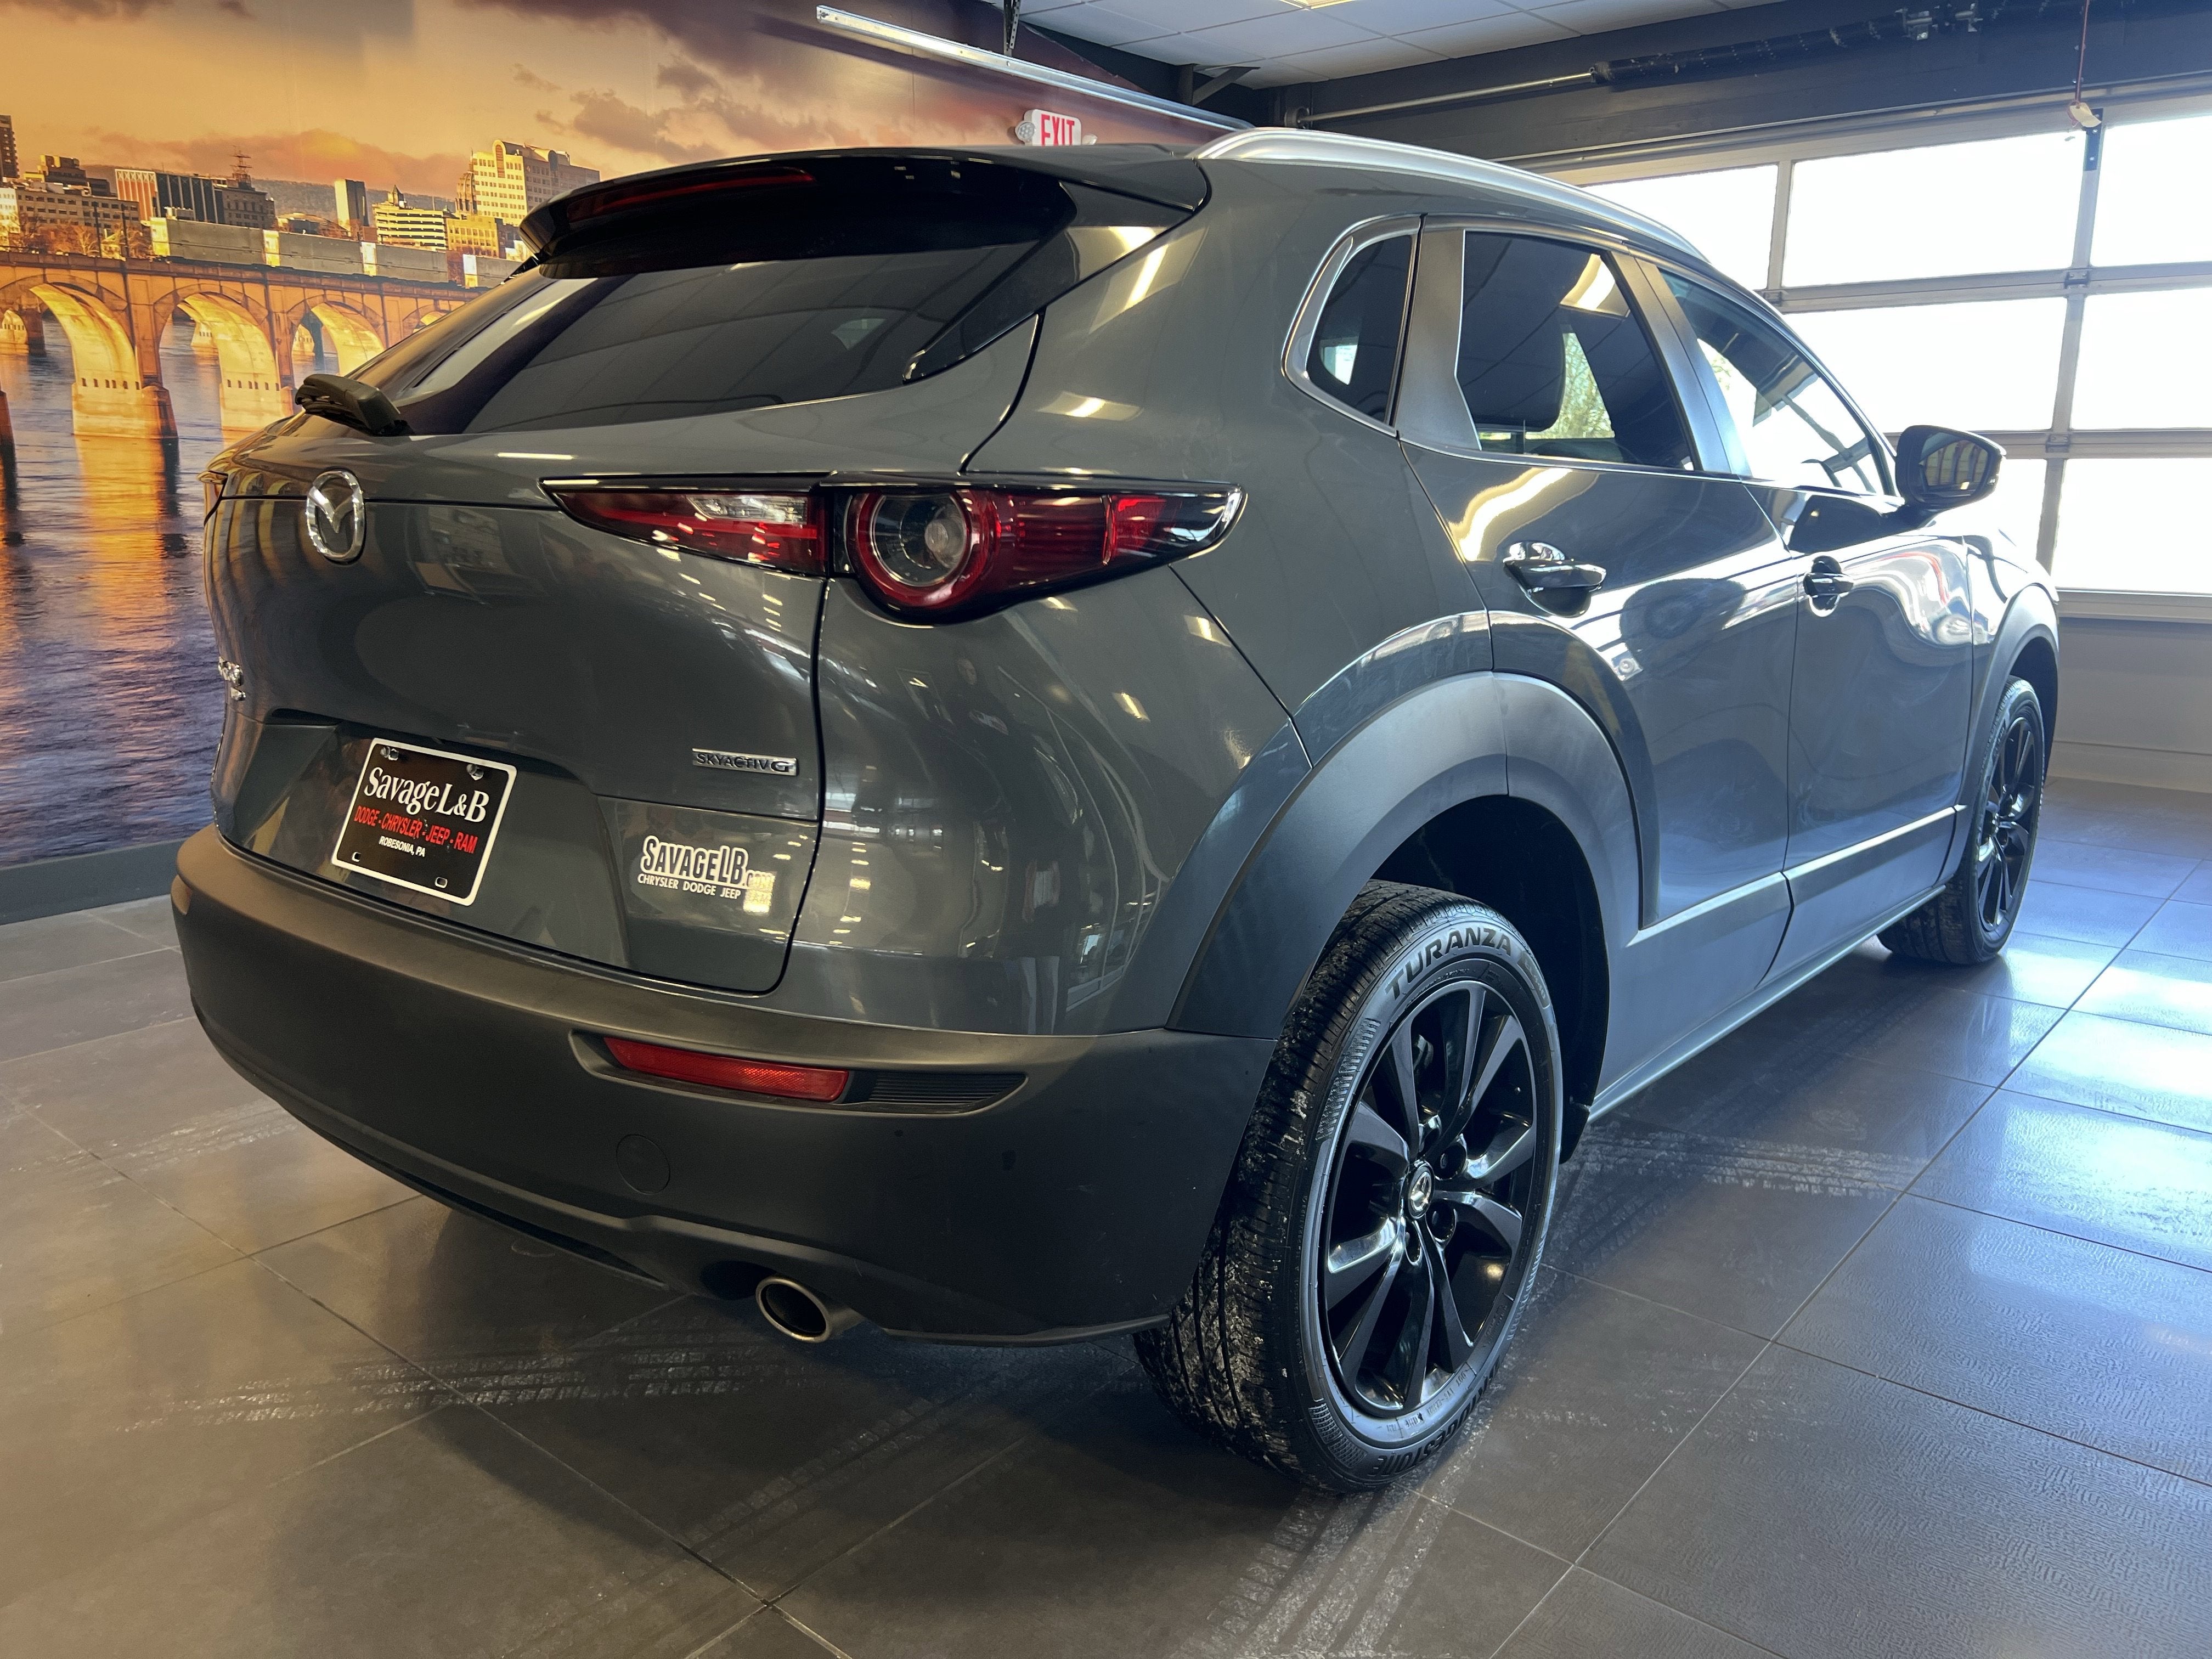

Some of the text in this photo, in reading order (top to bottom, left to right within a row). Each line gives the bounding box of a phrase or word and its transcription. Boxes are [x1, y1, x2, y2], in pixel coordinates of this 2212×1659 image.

[1041, 114, 1075, 146] EXIT
[697, 752, 769, 771] SKYACTIV
[354, 805, 478, 854] DODGE CHRYSLER JEEP RAM
[379, 836, 426, 857] ROBESONIA, PA
[637, 872, 680, 890] CHRYSLER
[682, 880, 717, 896] DODGE
[719, 886, 742, 900] JEEP
[1384, 927, 1512, 1002] TURANZA
